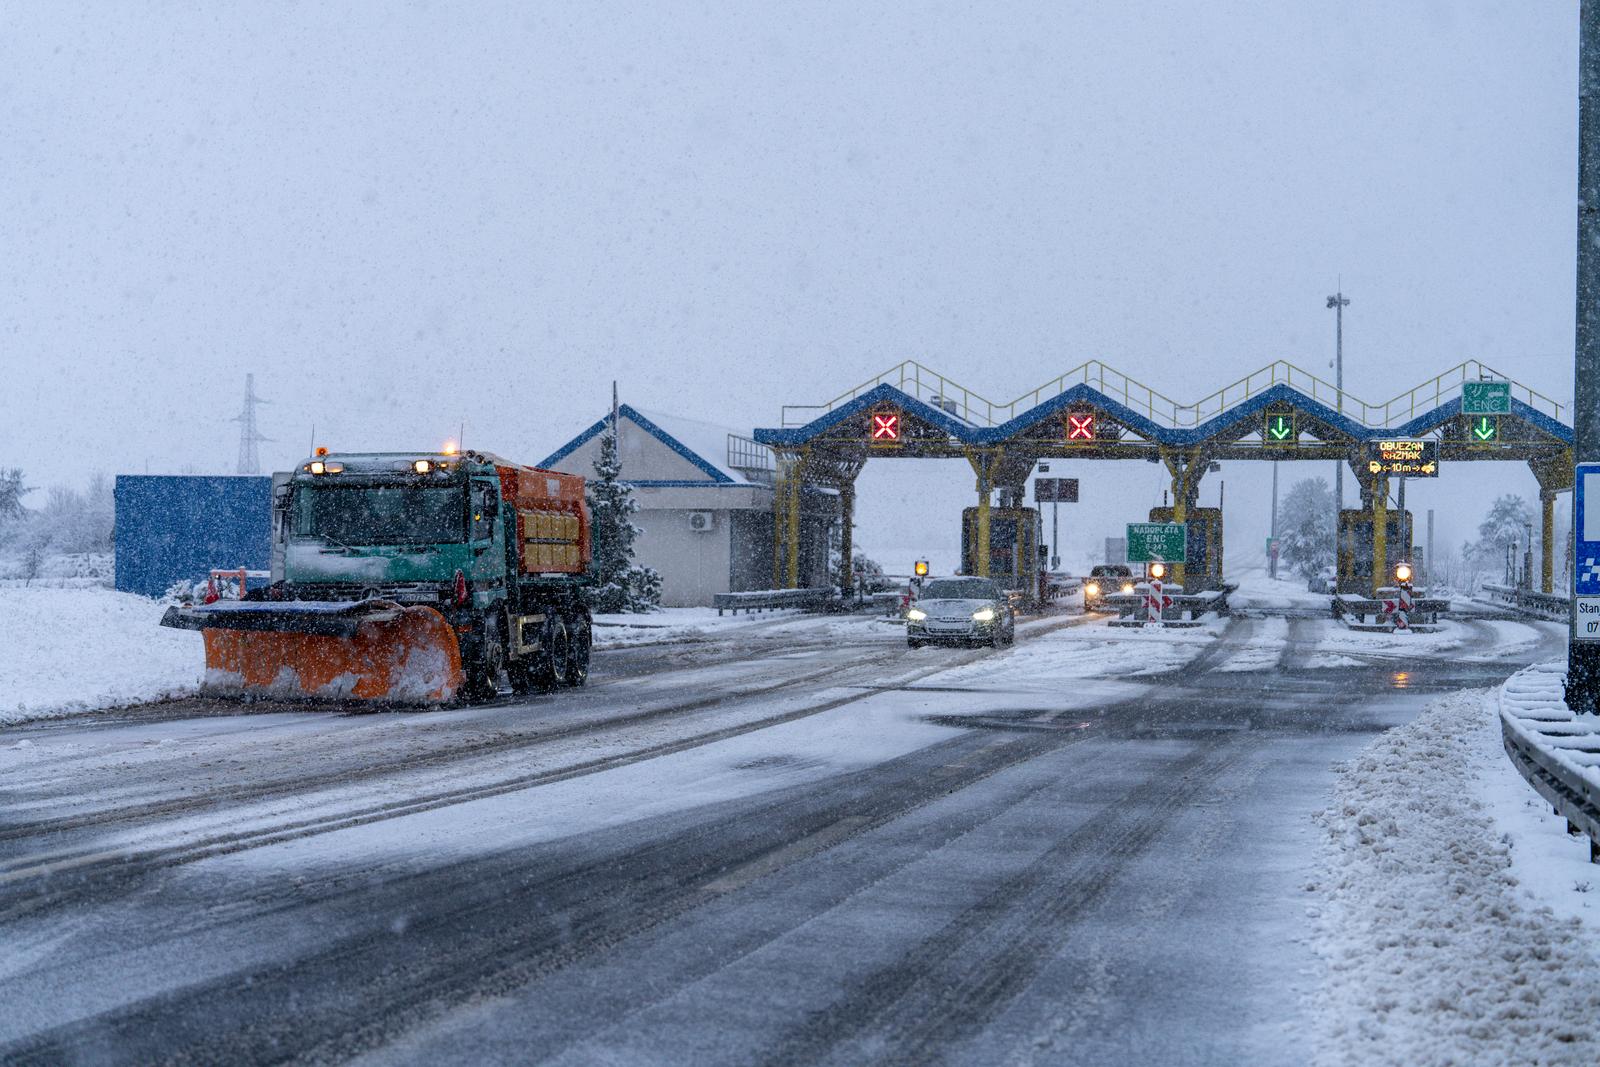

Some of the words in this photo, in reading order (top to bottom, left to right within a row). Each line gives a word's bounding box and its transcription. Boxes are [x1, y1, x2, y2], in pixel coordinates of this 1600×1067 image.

[1474, 399, 1500, 411] ENC
[1379, 441, 1424, 451] OBVEZAN
[1382, 451, 1421, 460] RAZMAK
[1133, 526, 1179, 534] NADOPLATA
[1146, 534, 1166, 543] ENC
[1579, 602, 1600, 616] Stan
[1587, 621, 1599, 633] 07
